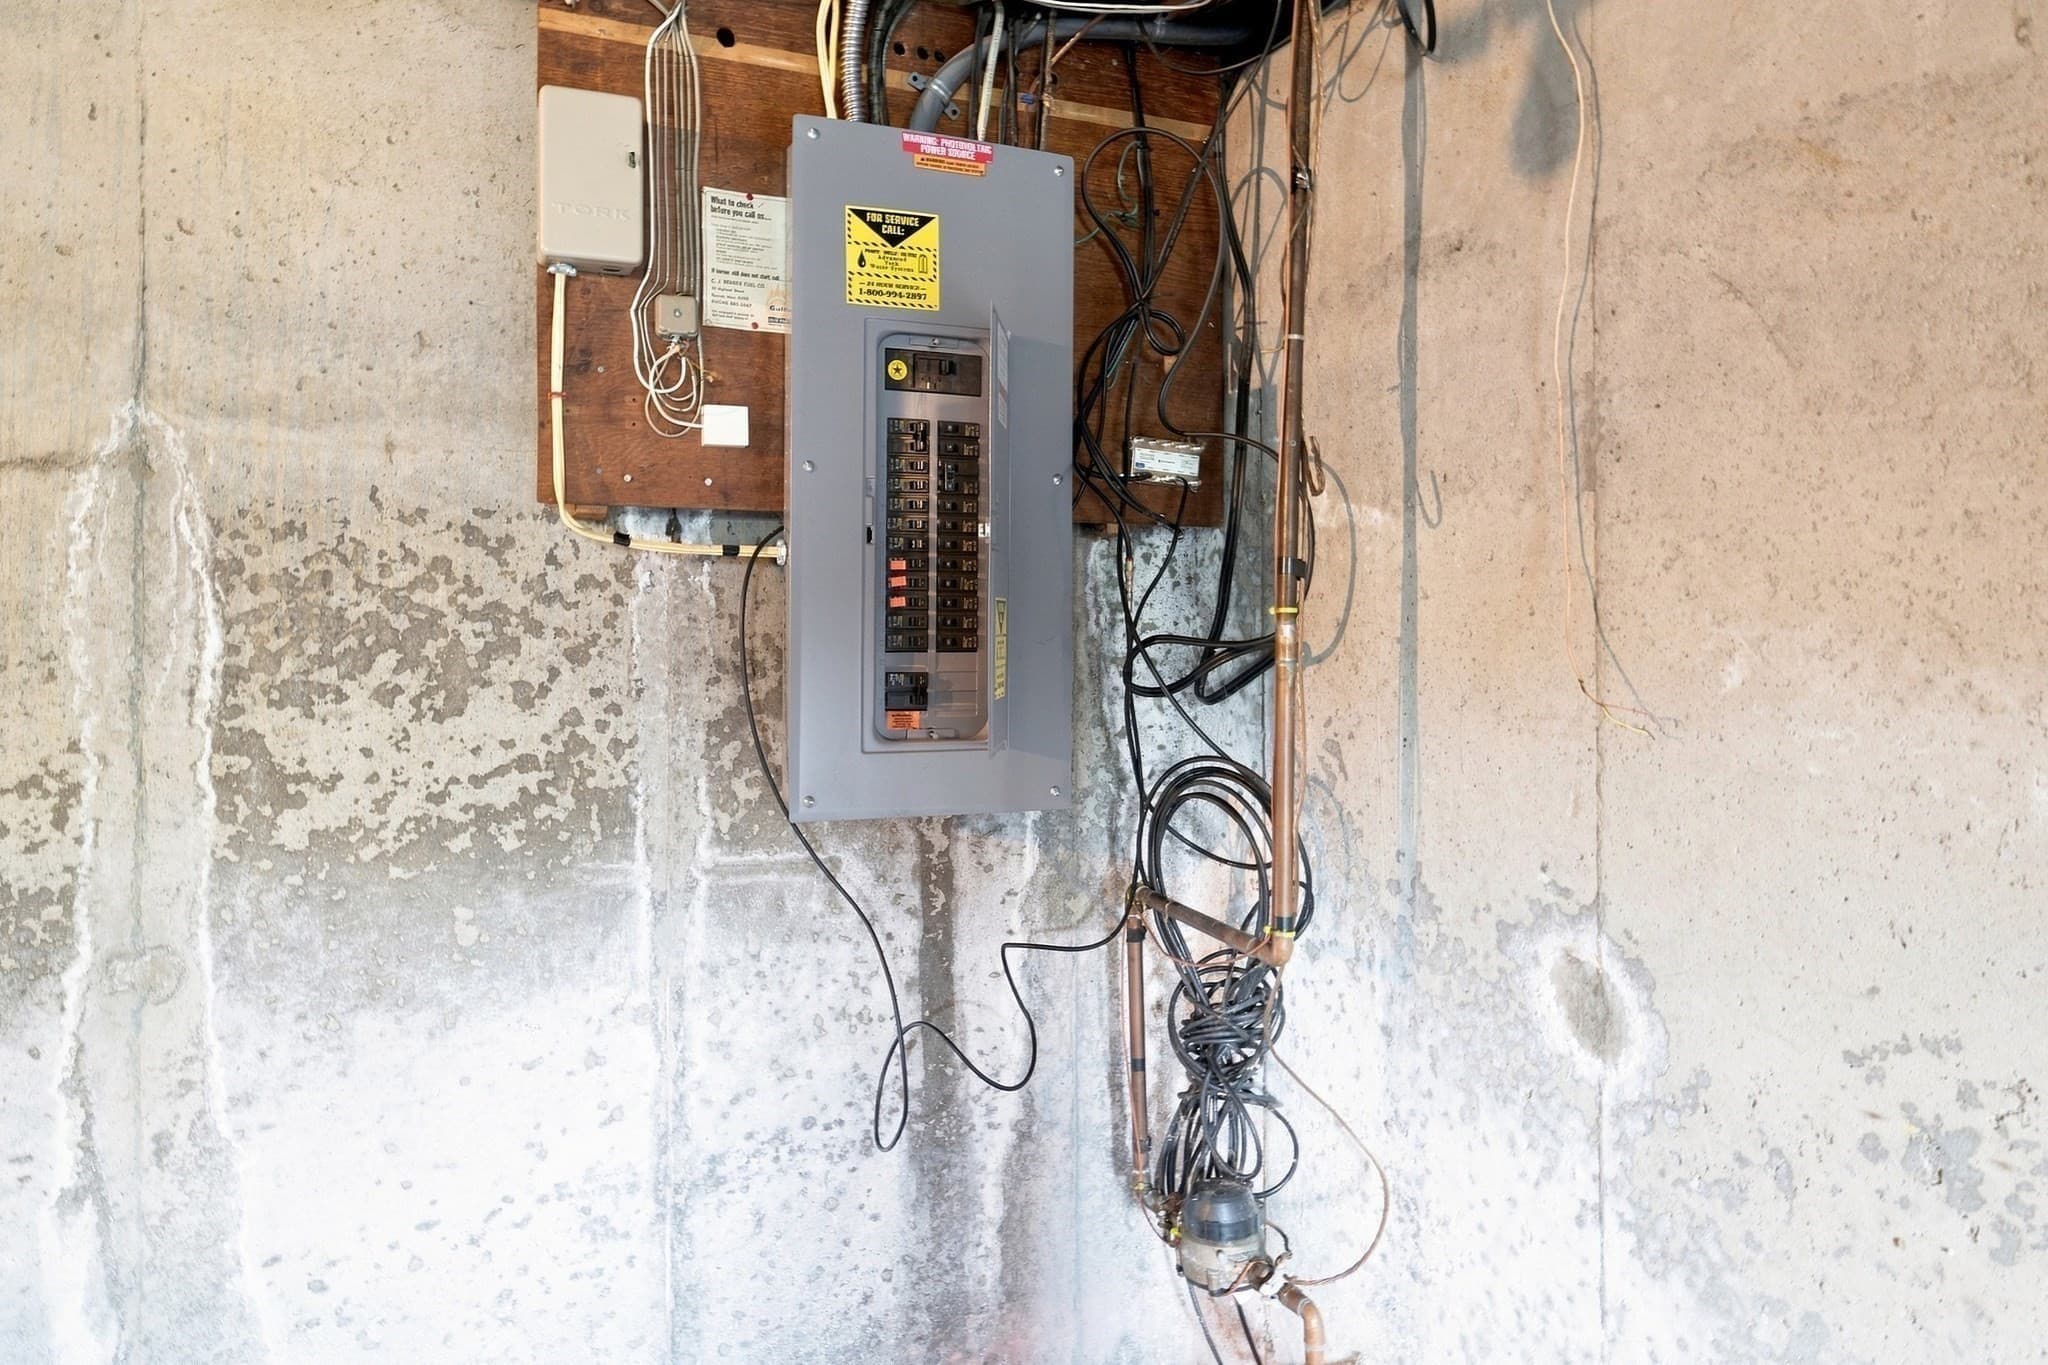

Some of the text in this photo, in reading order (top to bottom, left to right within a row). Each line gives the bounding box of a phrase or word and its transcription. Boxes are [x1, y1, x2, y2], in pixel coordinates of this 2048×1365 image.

[902, 132, 939, 146] WARNING:
[920, 144, 976, 161] POWER SOURCE
[711, 196, 754, 209] What to check
[551, 202, 632, 222] TORK
[710, 205, 731, 215] before
[732, 209, 743, 218] you
[744, 211, 756, 219] call
[866, 212, 920, 227] FOR SERVICE
[881, 224, 905, 236] CALL:
